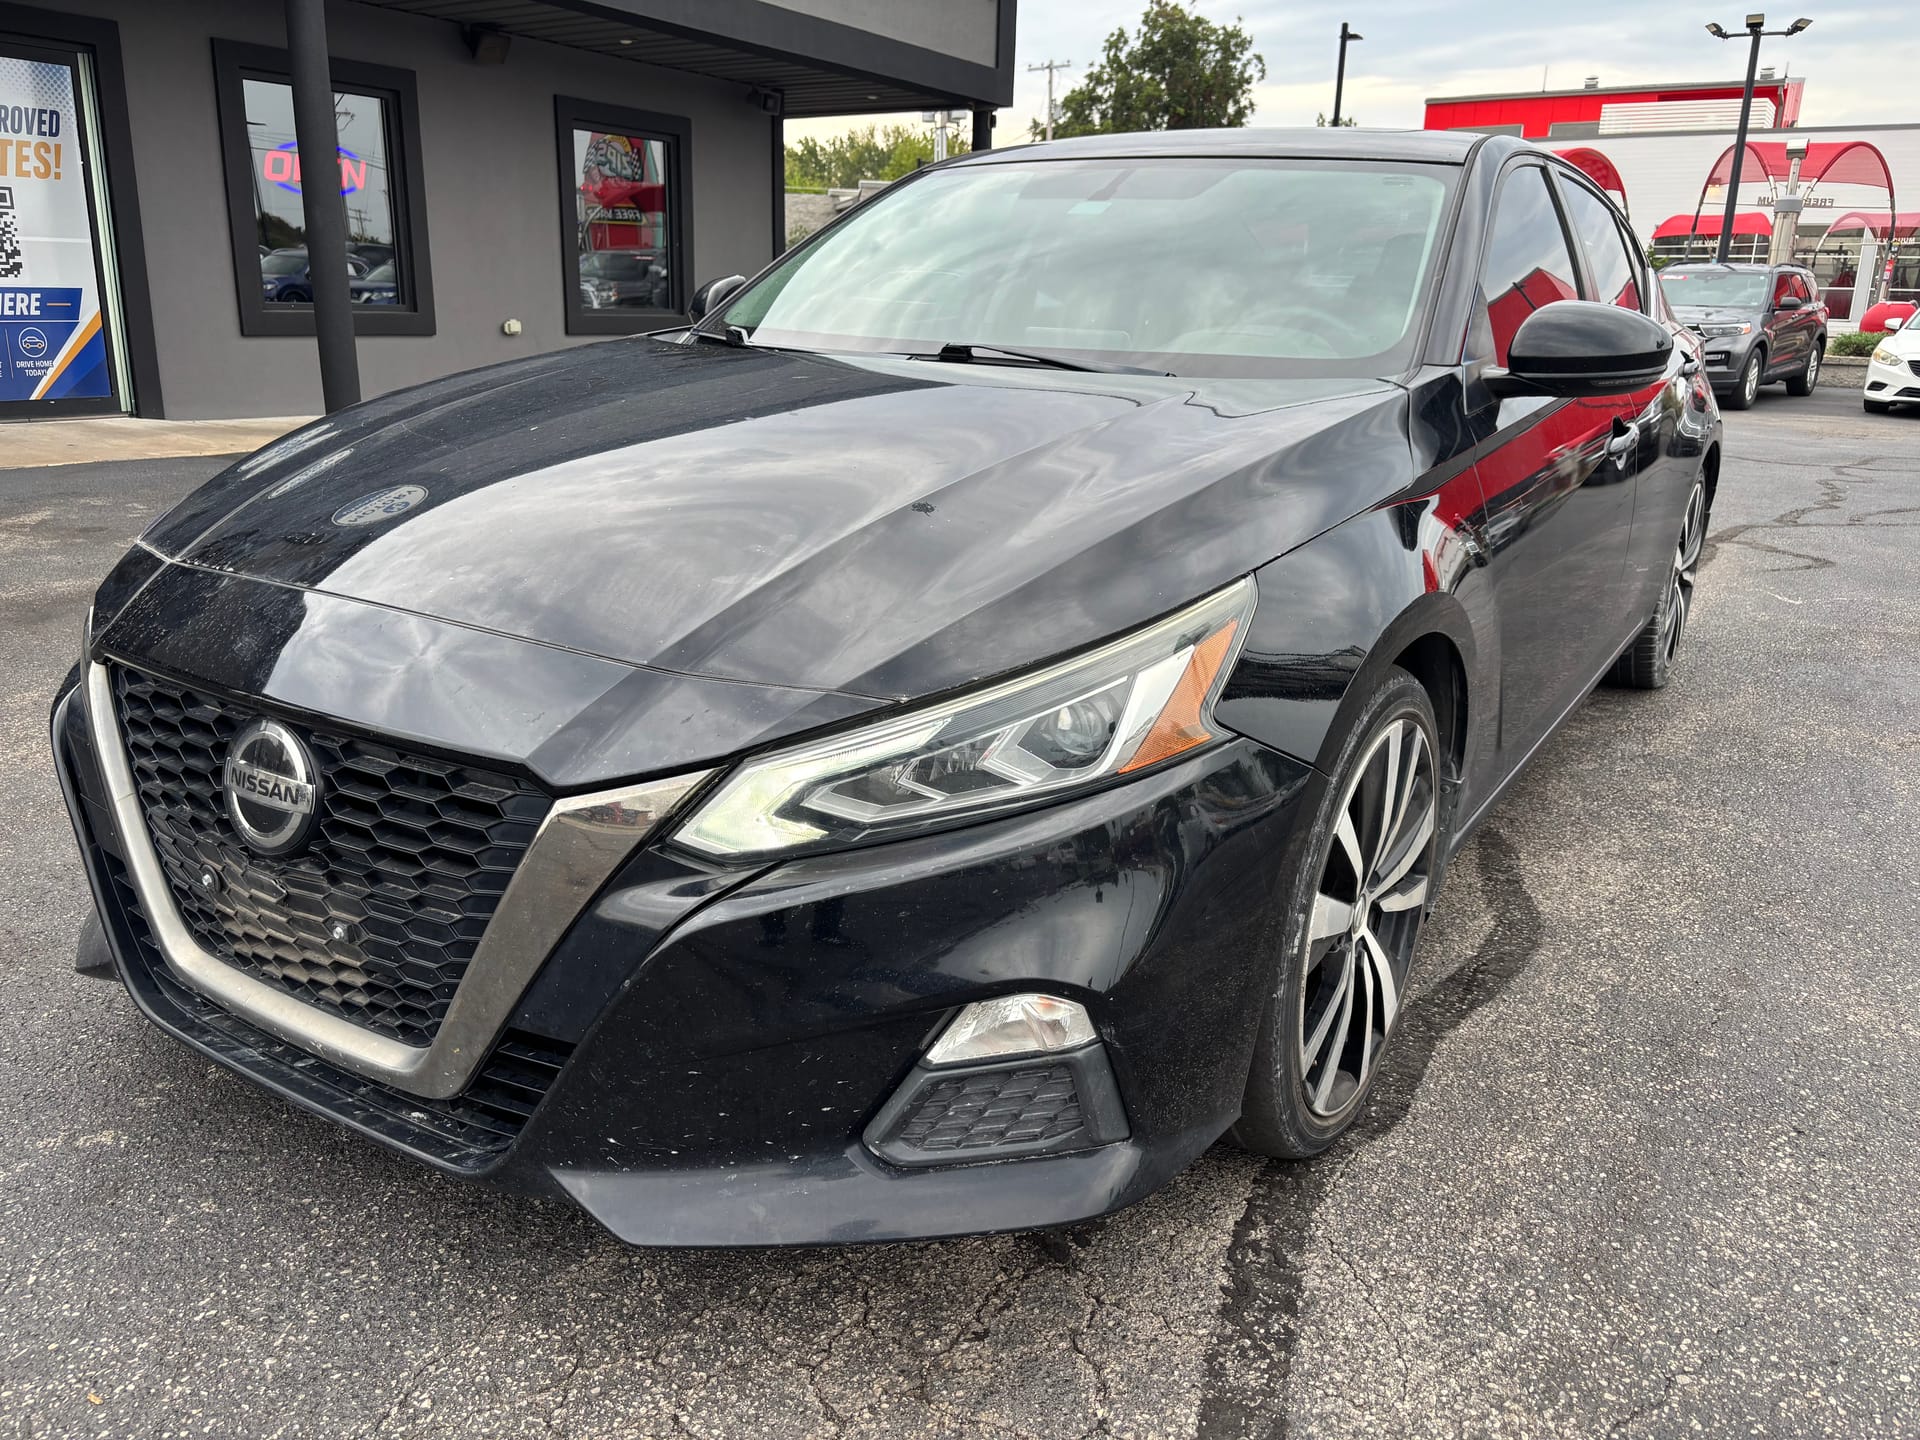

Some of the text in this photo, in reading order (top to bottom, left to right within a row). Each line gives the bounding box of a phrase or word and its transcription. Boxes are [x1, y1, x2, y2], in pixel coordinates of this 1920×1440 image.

[0, 105, 61, 137] ROVED
[0, 138, 62, 180] TES!
[263, 149, 367, 190] ON
[0, 293, 41, 315] ERE
[231, 767, 299, 805] NISSAN
